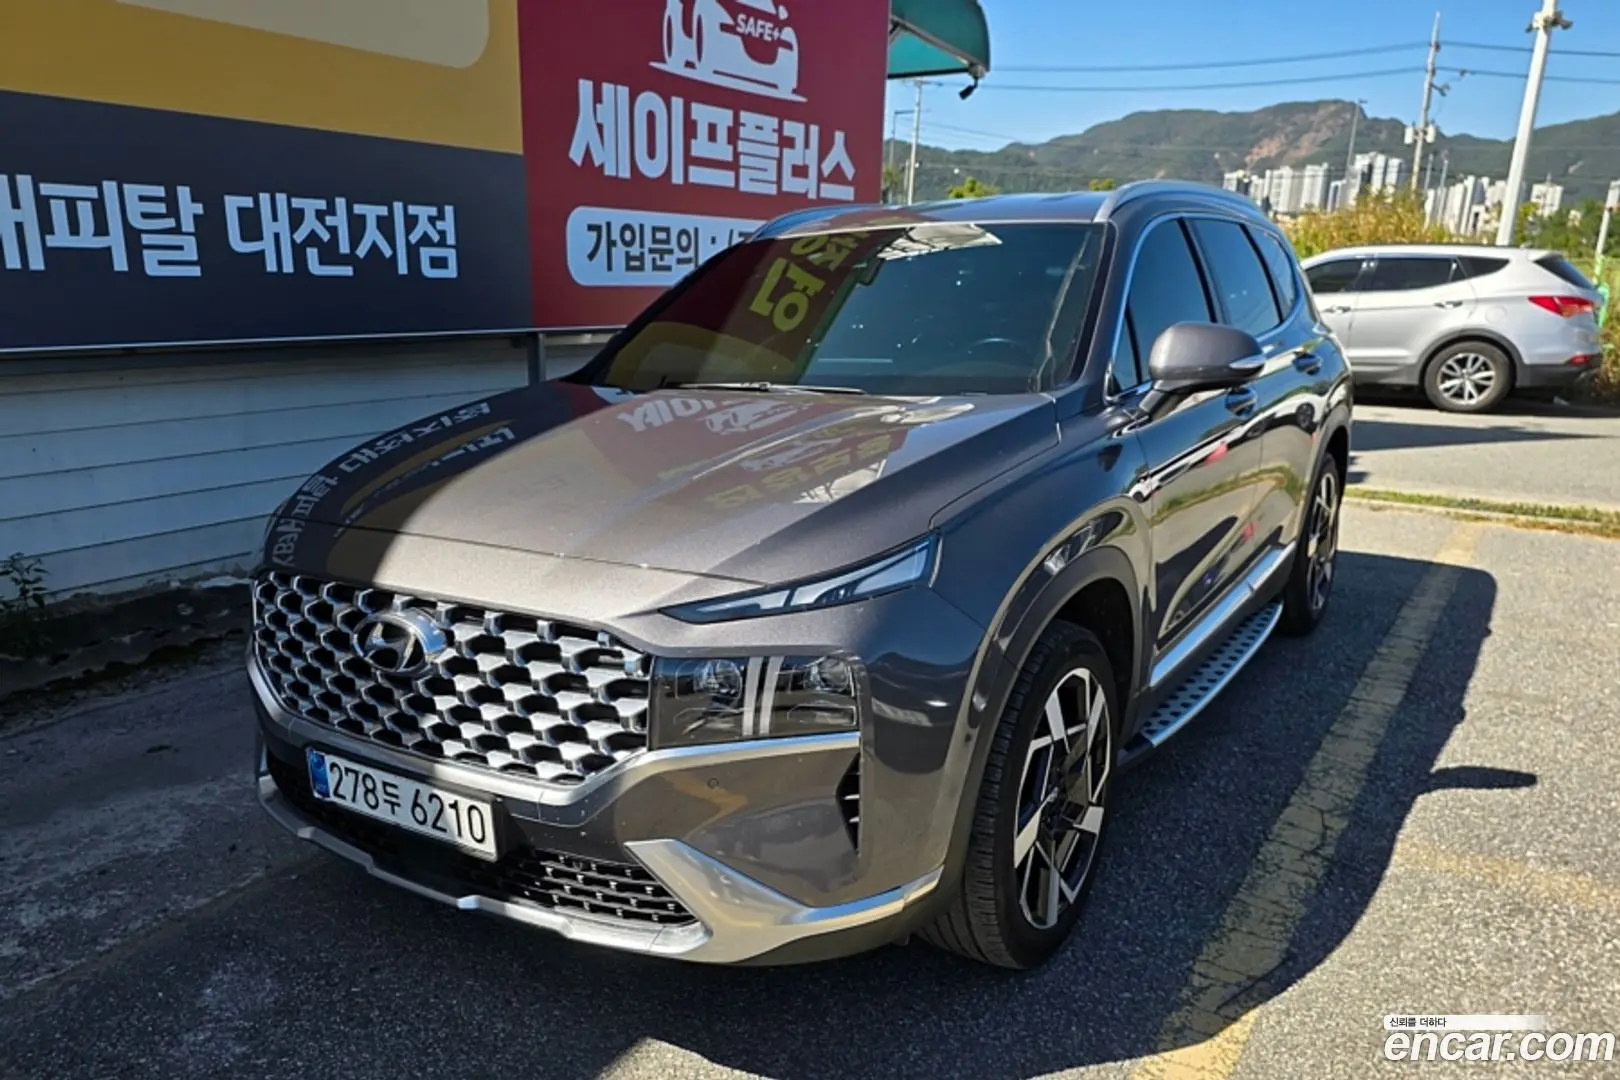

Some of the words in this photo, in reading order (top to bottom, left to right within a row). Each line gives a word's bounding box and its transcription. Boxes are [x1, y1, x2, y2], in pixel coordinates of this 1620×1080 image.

[736, 13, 781, 42] SAFE+
[568, 78, 857, 201] 세이프플러스
[223, 192, 459, 279] 대전지점
[329, 761, 402, 815] 278두
[411, 788, 486, 844] 6210
